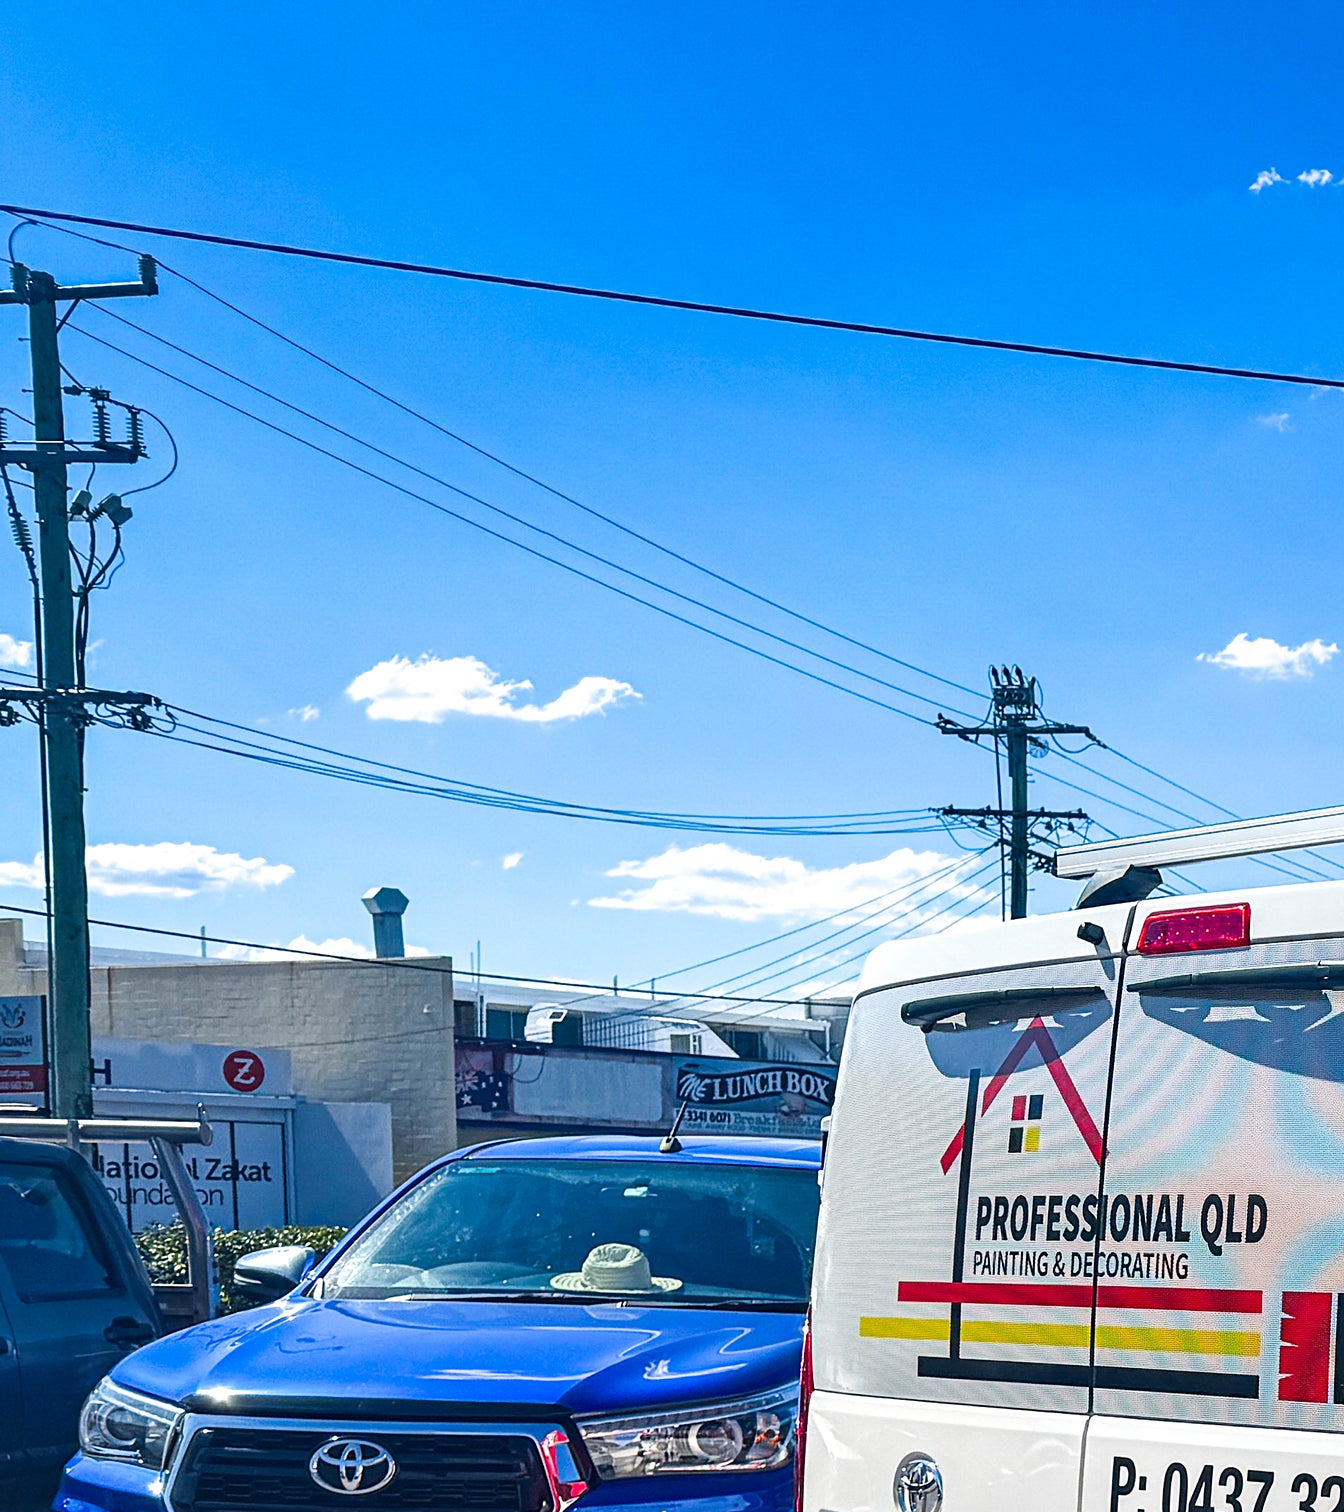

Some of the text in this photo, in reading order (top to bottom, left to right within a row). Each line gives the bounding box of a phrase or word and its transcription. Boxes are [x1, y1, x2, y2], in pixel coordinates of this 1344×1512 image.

[713, 1071, 782, 1100] LUNCH
[786, 1071, 829, 1102] BOX
[205, 1158, 272, 1182] Zakat
[975, 1194, 1267, 1256] PROFESSIONAL QLD
[973, 1250, 1189, 1280] PAINTING & DECORATING
